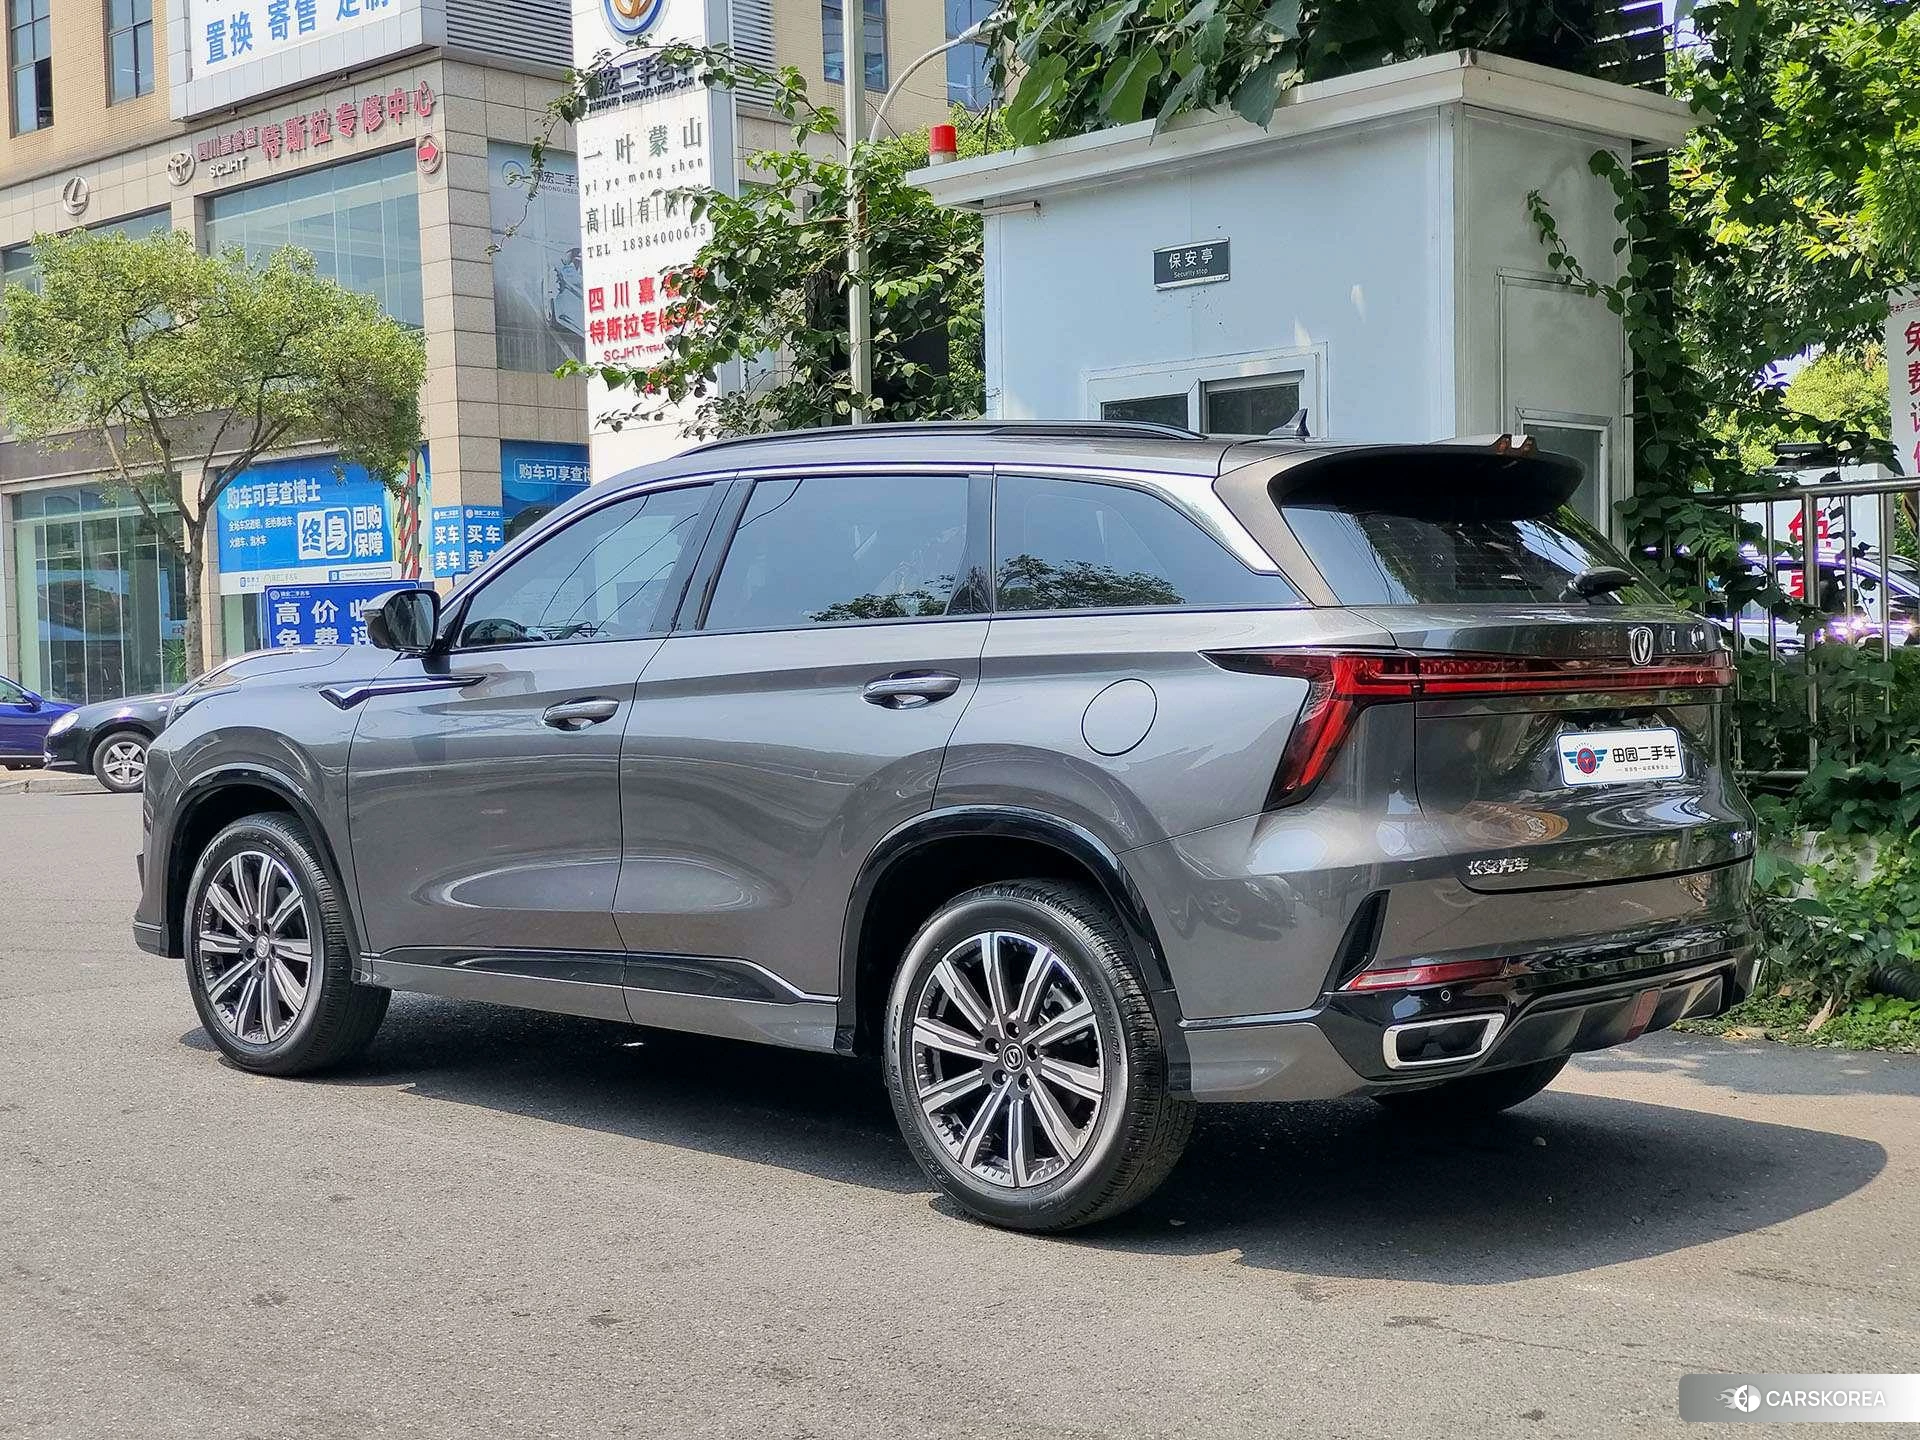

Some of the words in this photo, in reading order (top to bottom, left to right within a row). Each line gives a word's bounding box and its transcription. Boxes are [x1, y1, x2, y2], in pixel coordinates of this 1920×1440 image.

[206, 11, 253, 65] 置换
[261, 81, 435, 160] 特斯拉专修中心
[209, 157, 246, 177] SCJHT
[587, 243, 611, 258] TEL
[622, 223, 706, 251] 18384000675
[1169, 247, 1213, 269] 保安亭
[226, 477, 321, 510] 购车可享查博士
[353, 504, 382, 531] 回购
[301, 515, 347, 552] 终身
[354, 531, 384, 557] 保障
[435, 524, 460, 546] 买车
[467, 524, 501, 544] 买车
[435, 550, 461, 570] 卖车
[1613, 745, 1676, 763] 田园二手车
[1467, 857, 1530, 876] 长安汽车
